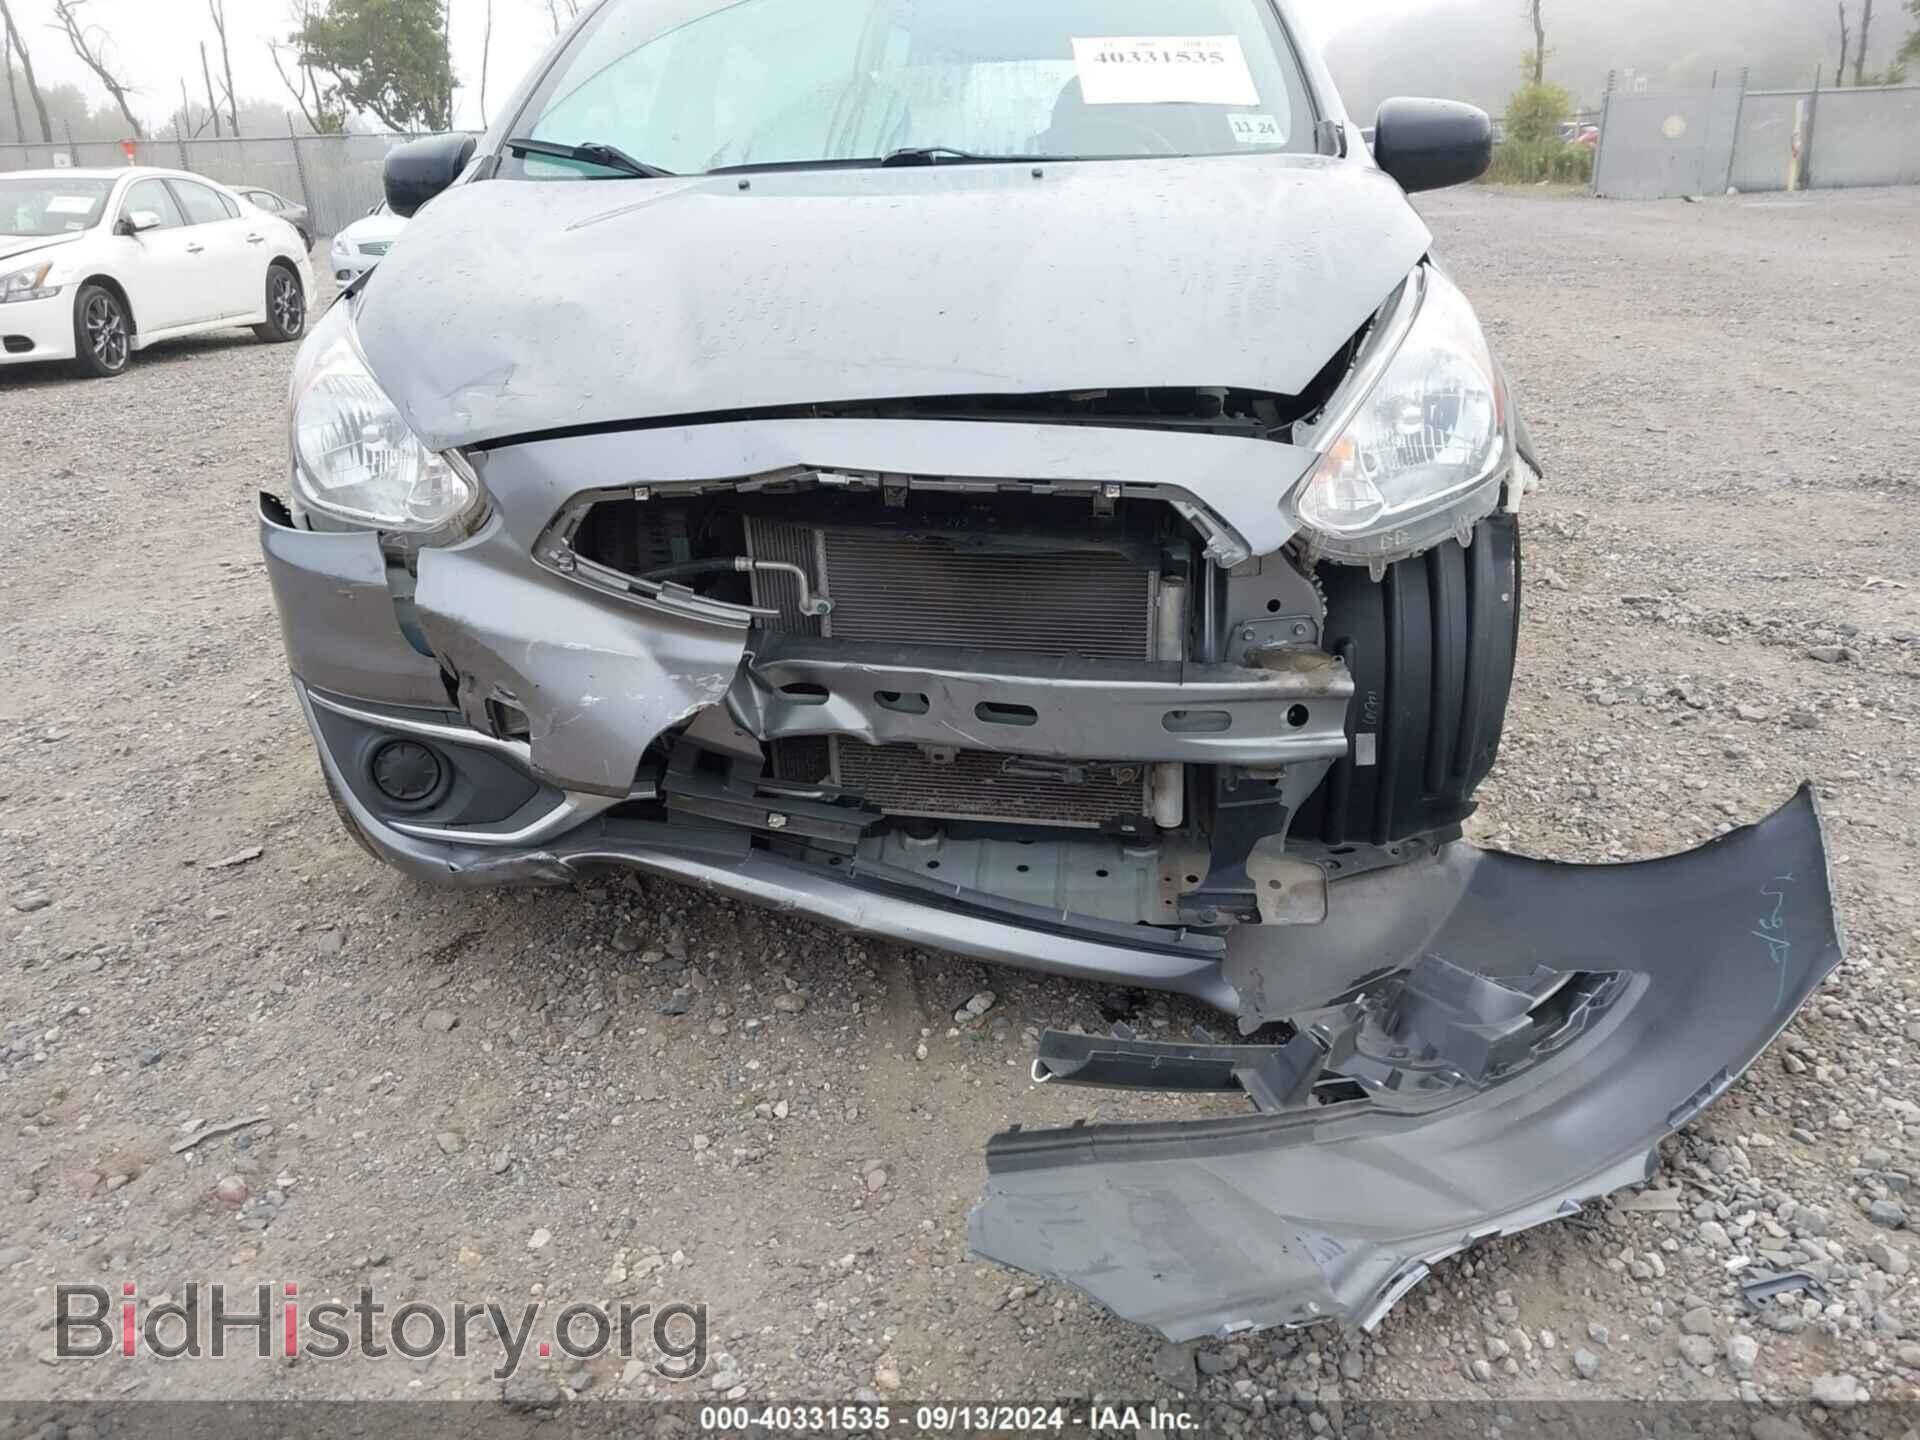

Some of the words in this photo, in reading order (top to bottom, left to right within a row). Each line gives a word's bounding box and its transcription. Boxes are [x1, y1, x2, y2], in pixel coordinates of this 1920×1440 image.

[1094, 50, 1225, 64] 40331535
[1234, 120, 1254, 133] 11
[1258, 121, 1275, 135] 24
